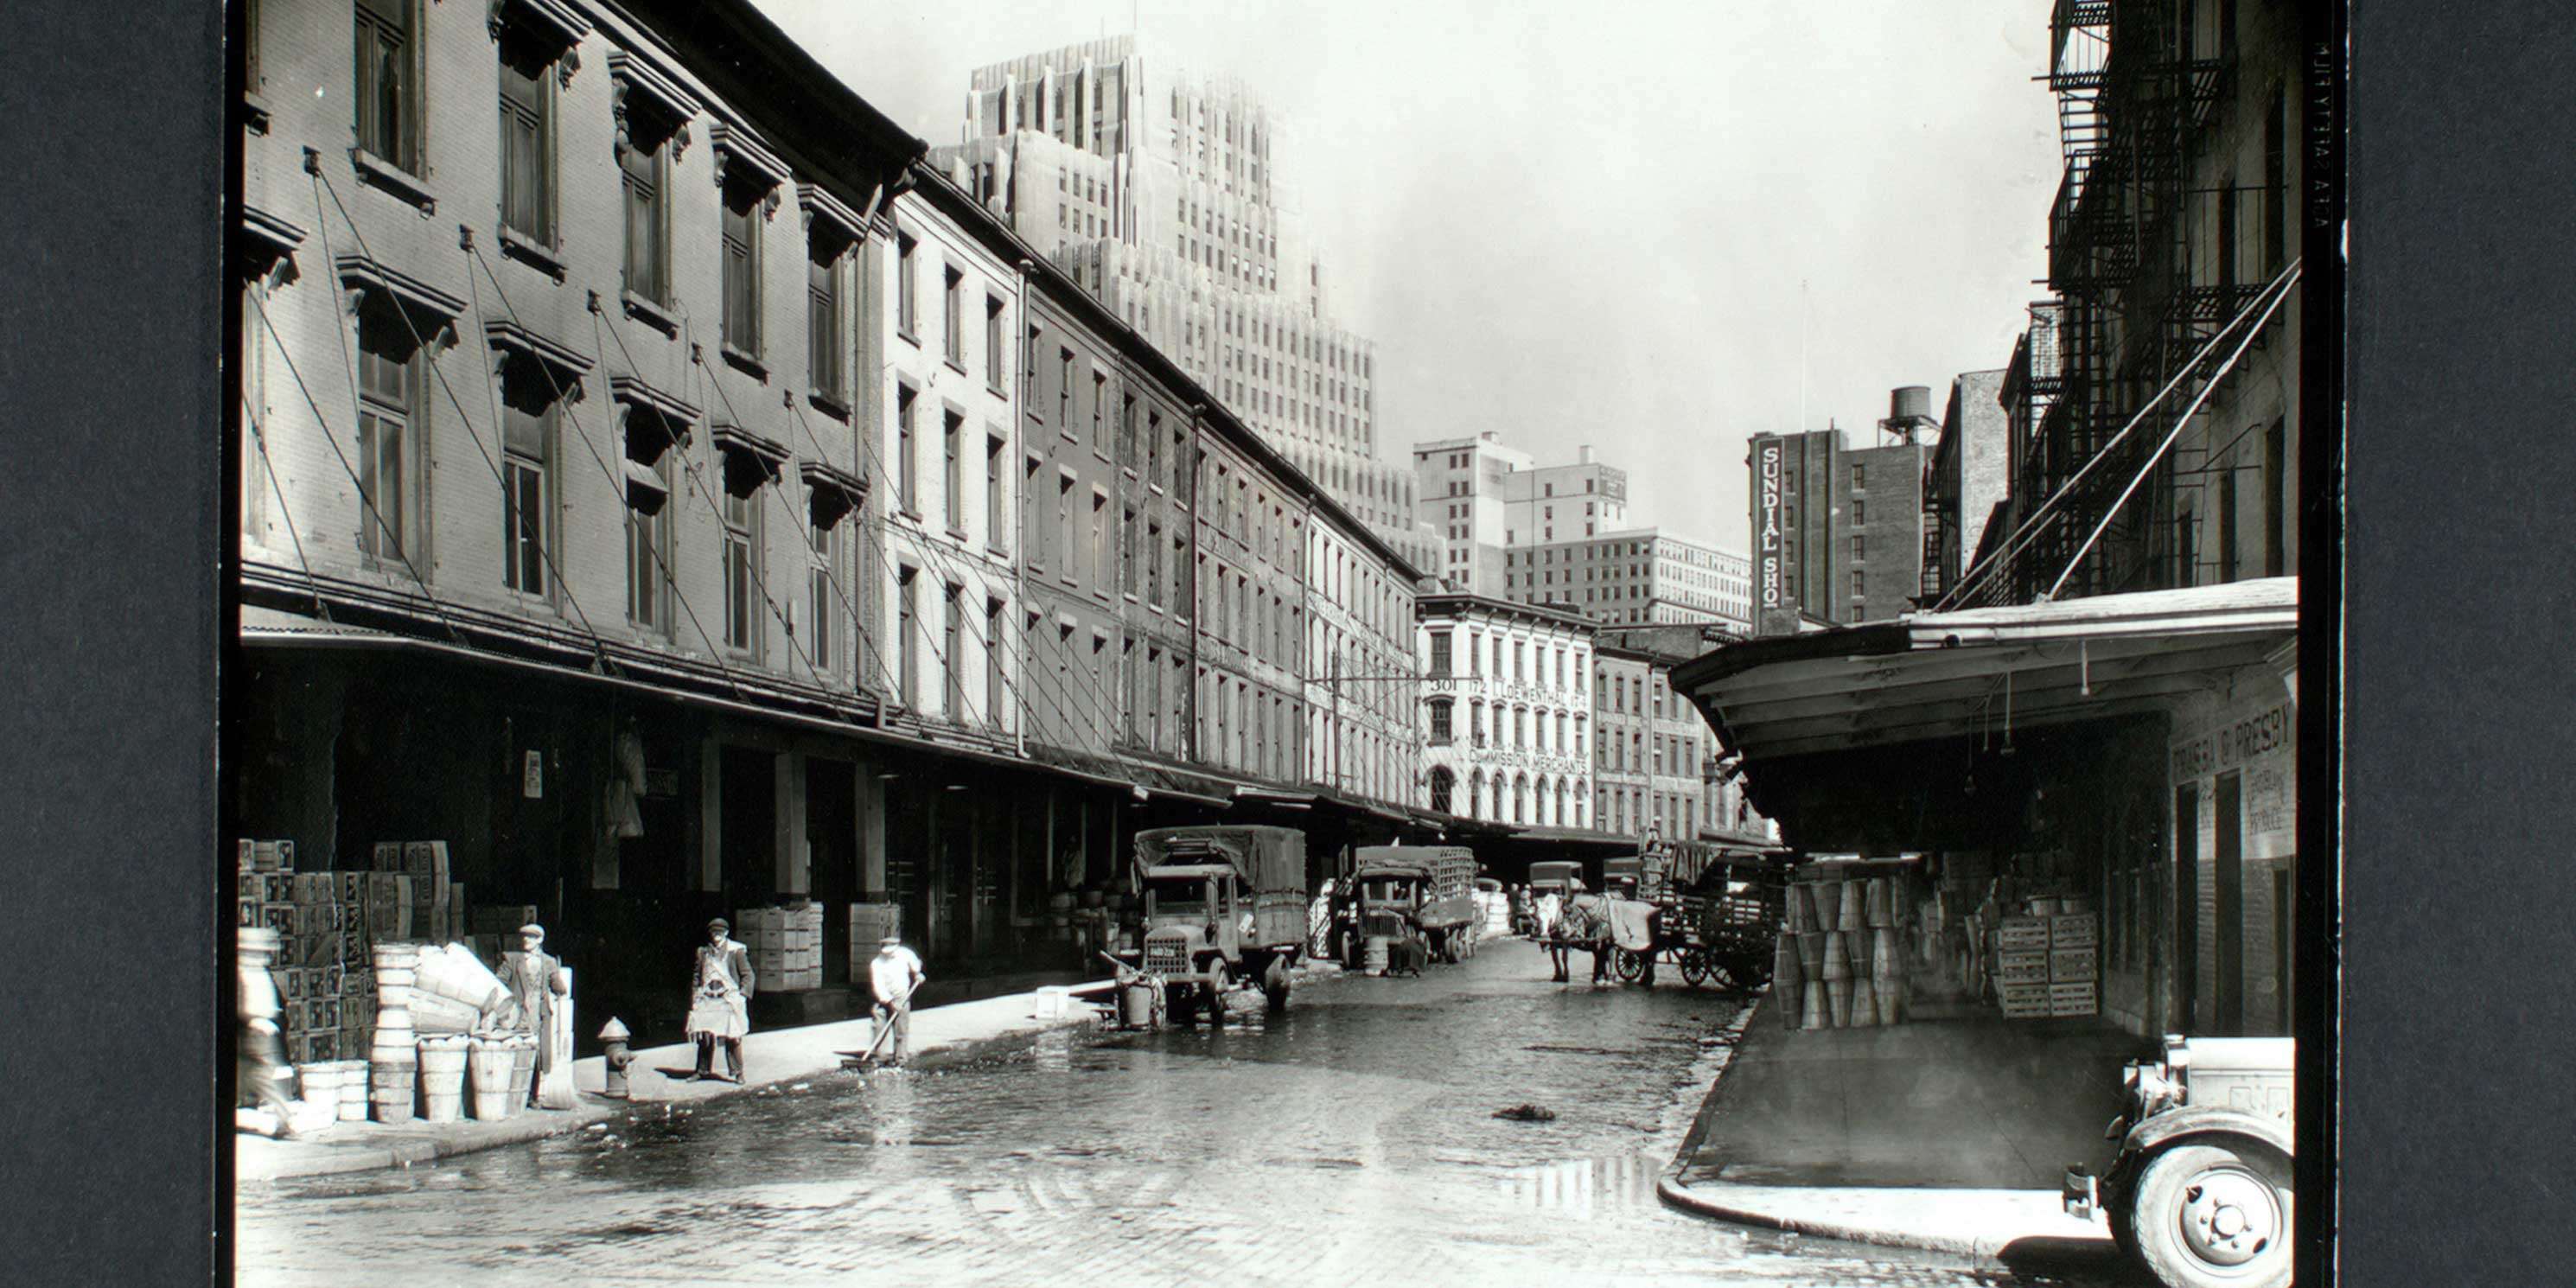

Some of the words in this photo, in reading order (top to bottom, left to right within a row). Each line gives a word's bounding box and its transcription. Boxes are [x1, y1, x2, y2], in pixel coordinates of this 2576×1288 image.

[1763, 447, 1779, 552] SUNDIAL
[1763, 557, 1779, 609] SHO
[1430, 679, 1457, 692] 301
[1469, 680, 1488, 694] 172
[1501, 683, 1566, 706] LOEWENTHAL
[2235, 702, 2290, 762] PRESBY
[1469, 749, 1529, 768] COMMISSION
[1533, 755, 1588, 775] MERCHANTS
